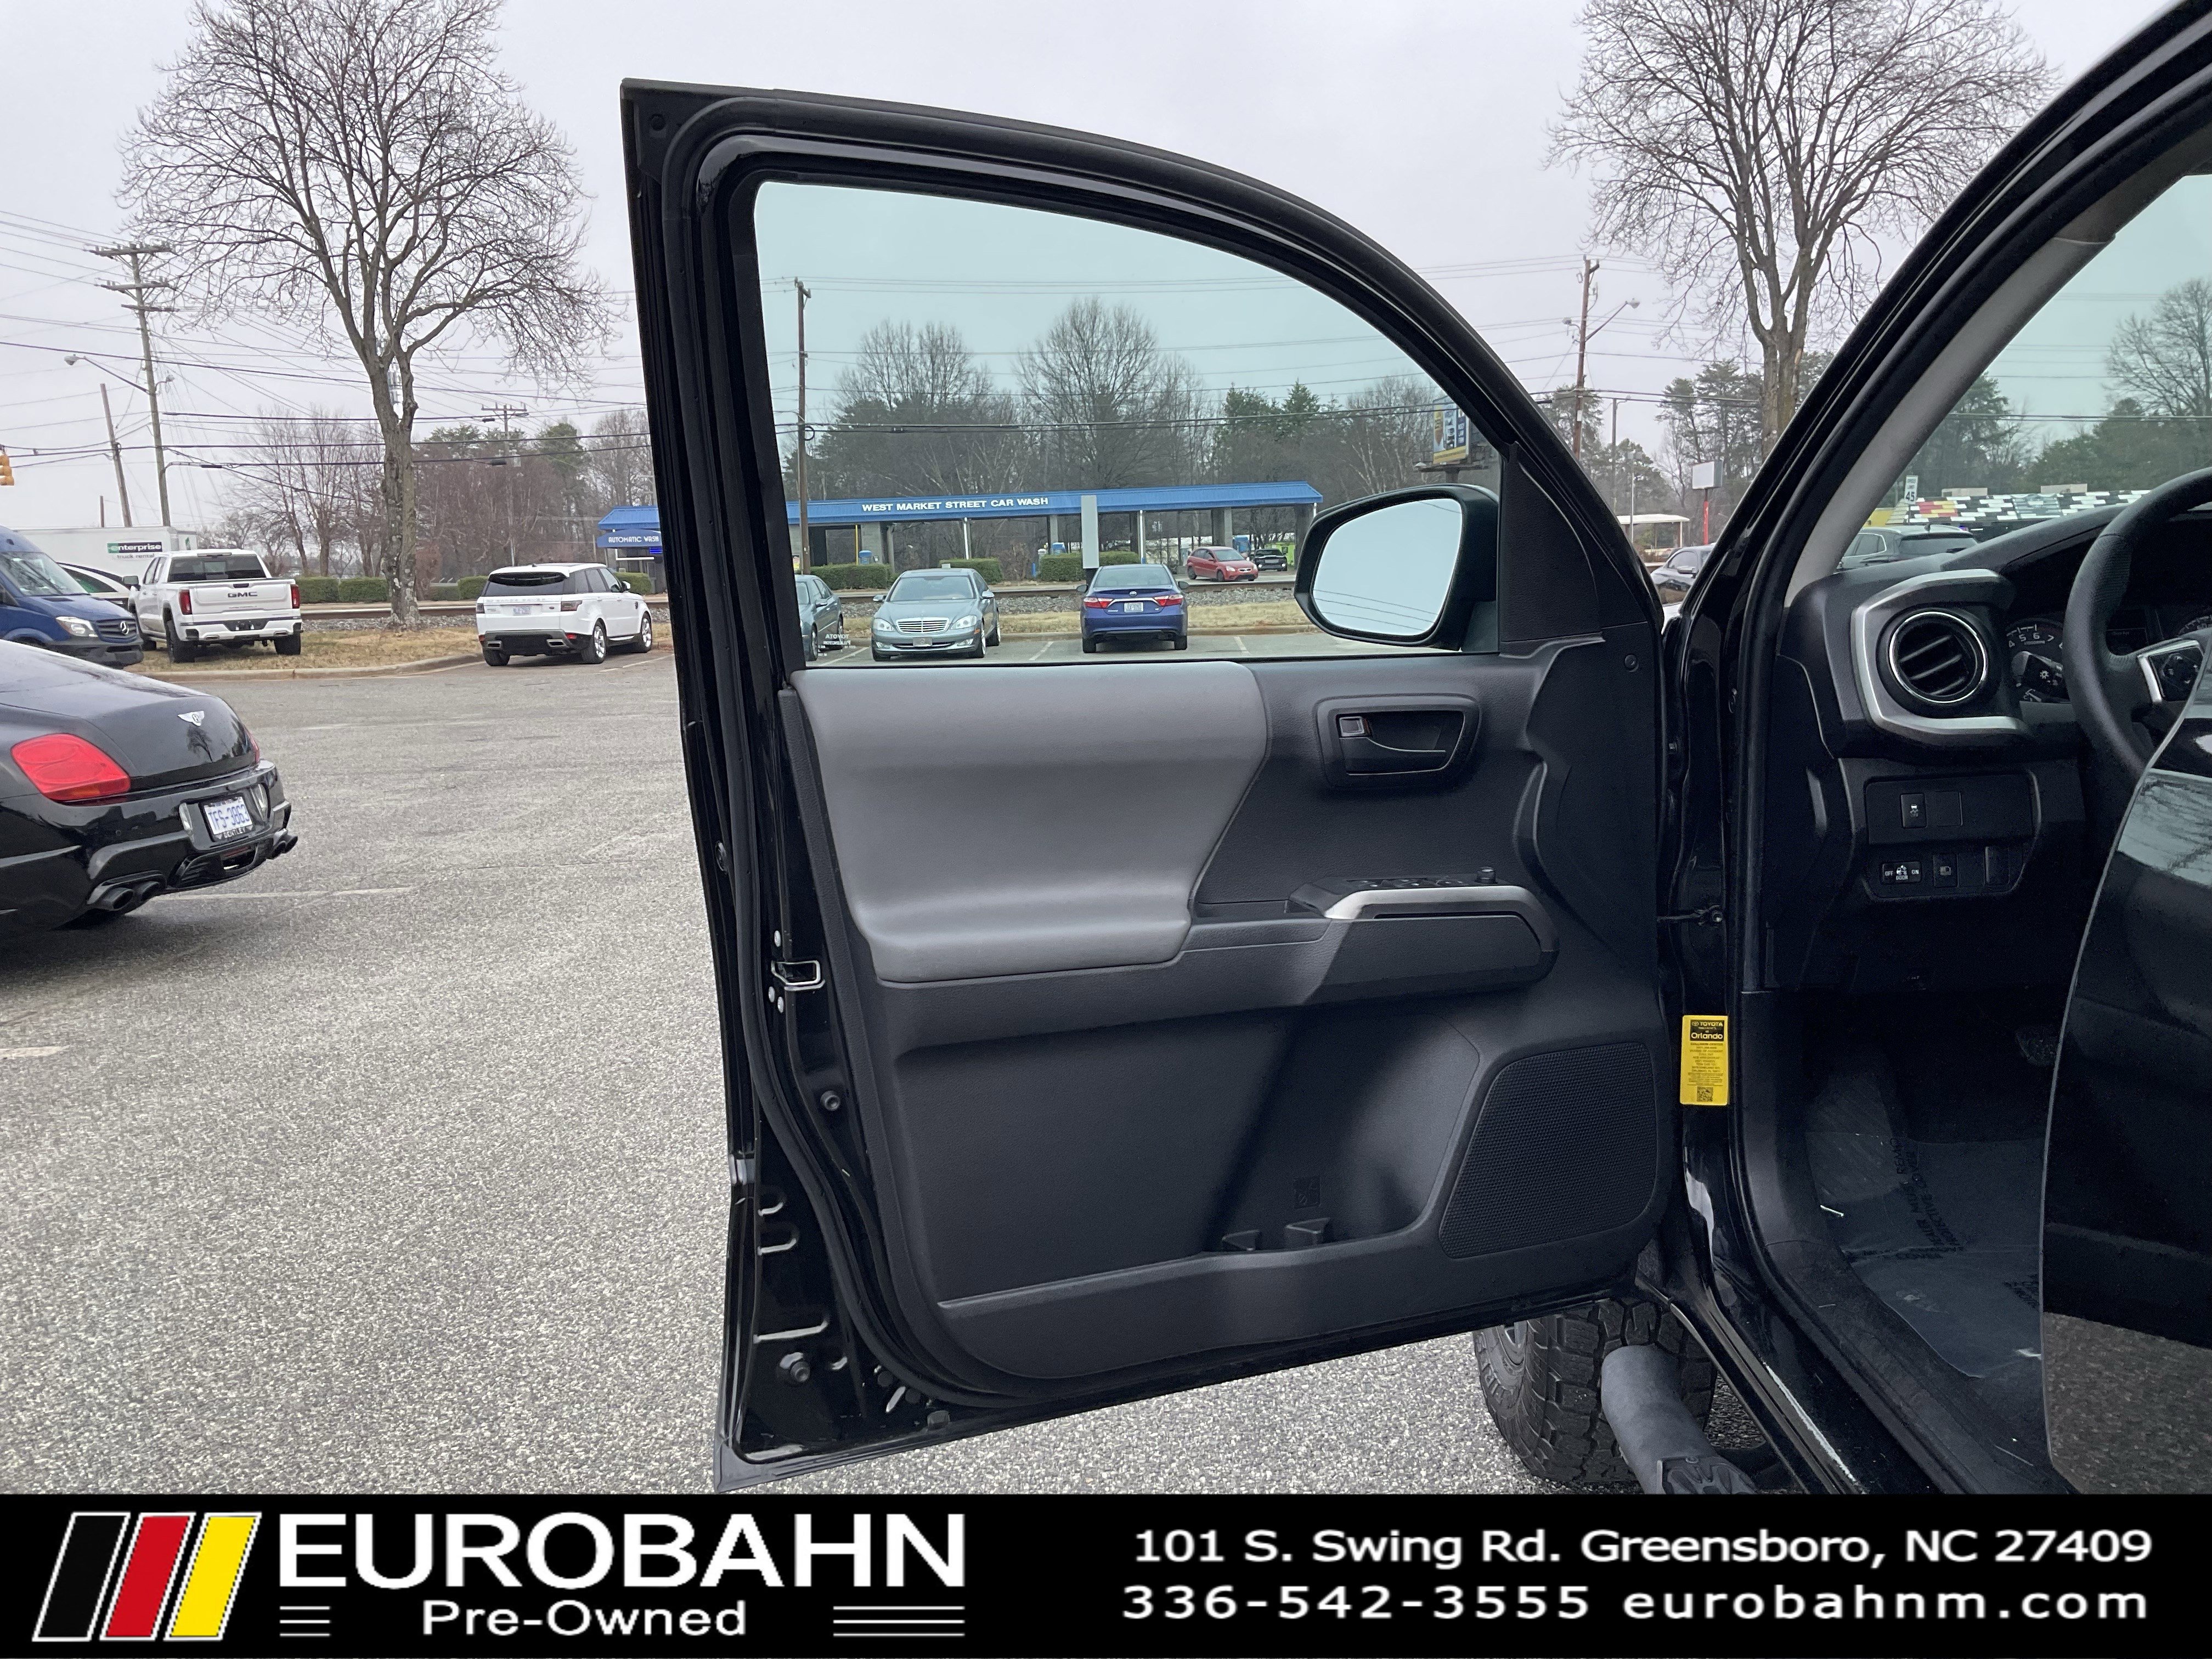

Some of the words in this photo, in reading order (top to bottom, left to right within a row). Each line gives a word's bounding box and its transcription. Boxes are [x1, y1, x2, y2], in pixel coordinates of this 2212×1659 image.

[1905, 491, 1915, 501] 45
[896, 502, 941, 511] MARKET
[945, 500, 987, 509] STREET
[990, 499, 1014, 507] CAR
[1017, 497, 1048, 506] WASH
[110, 543, 162, 551] enterprise
[2019, 634, 2027, 642] 5
[208, 804, 250, 831] TFS-3863
